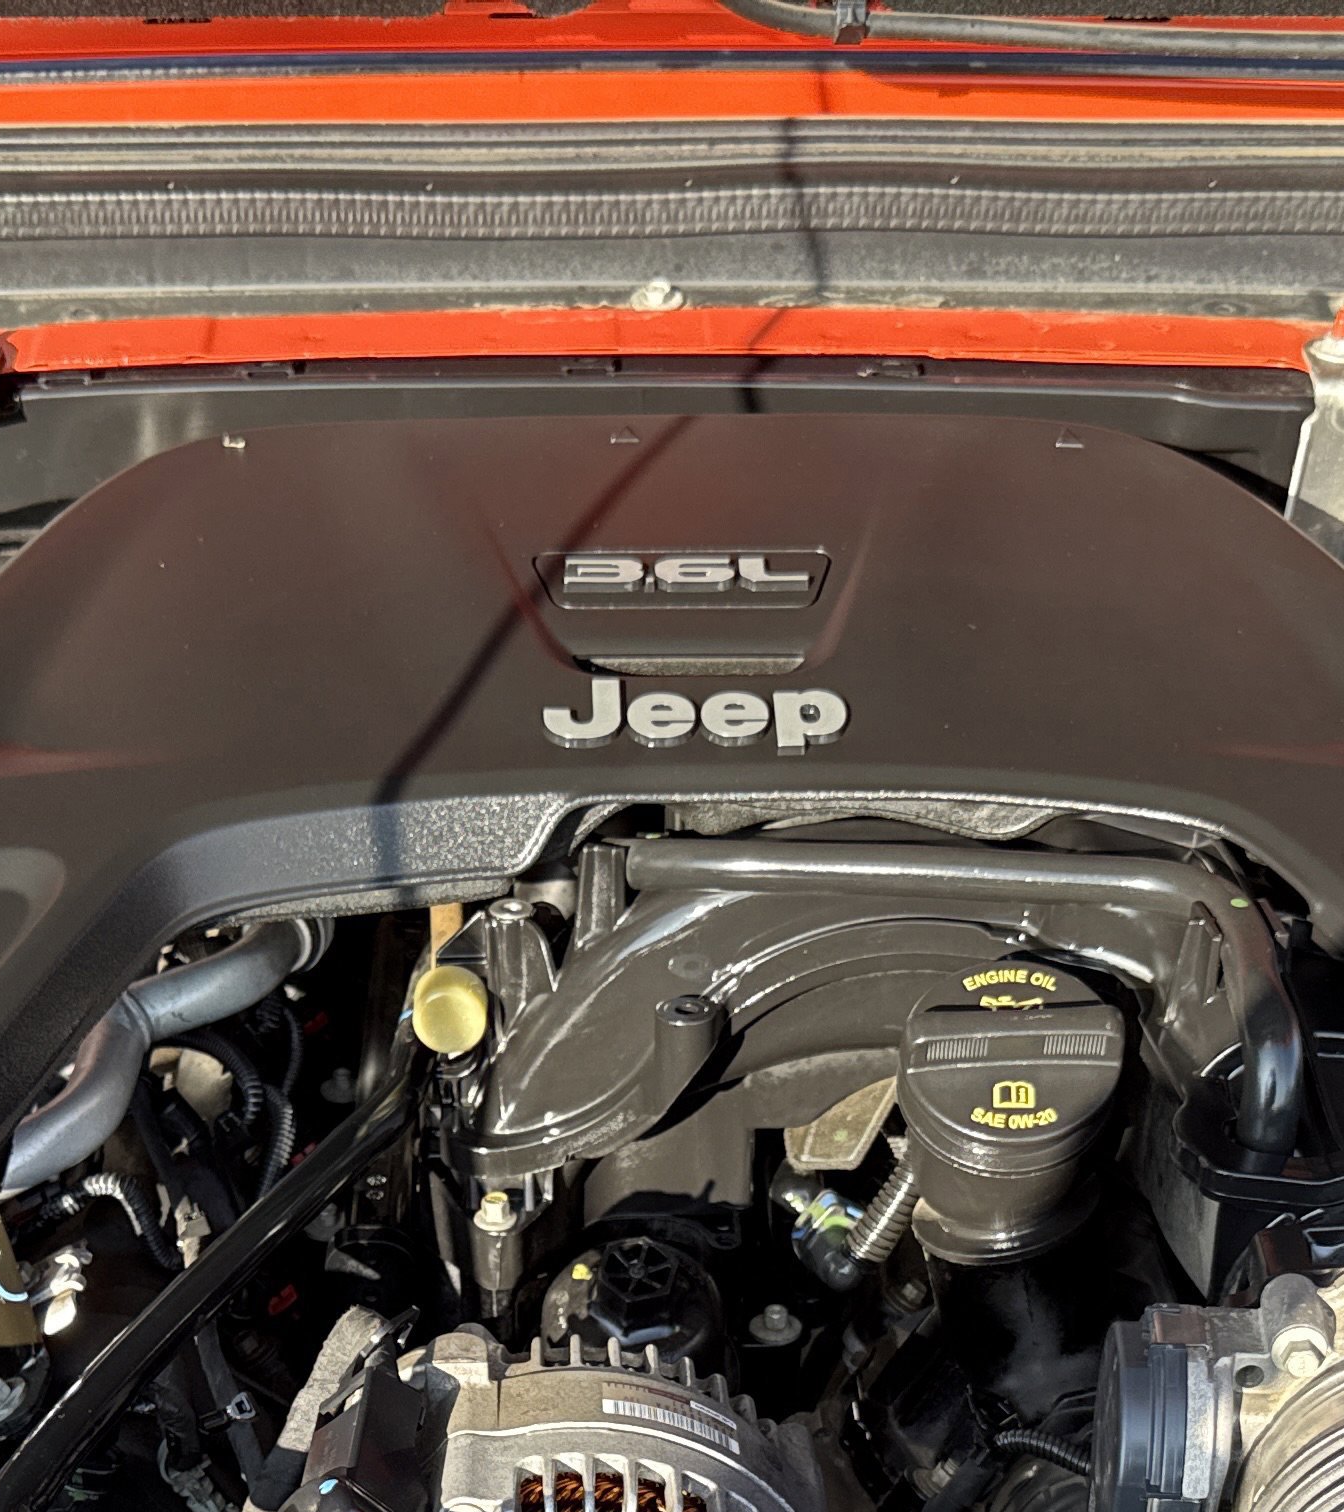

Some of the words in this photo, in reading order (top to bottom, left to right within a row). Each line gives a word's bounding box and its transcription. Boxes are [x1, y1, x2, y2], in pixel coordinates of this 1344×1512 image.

[563, 555, 813, 593] 3.6L
[542, 676, 851, 756] Jeep
[962, 968, 1028, 992] ENGINE
[1030, 969, 1057, 992] OIL
[970, 1106, 1005, 1129] SAE
[1007, 1106, 1058, 1130] 0W-20
